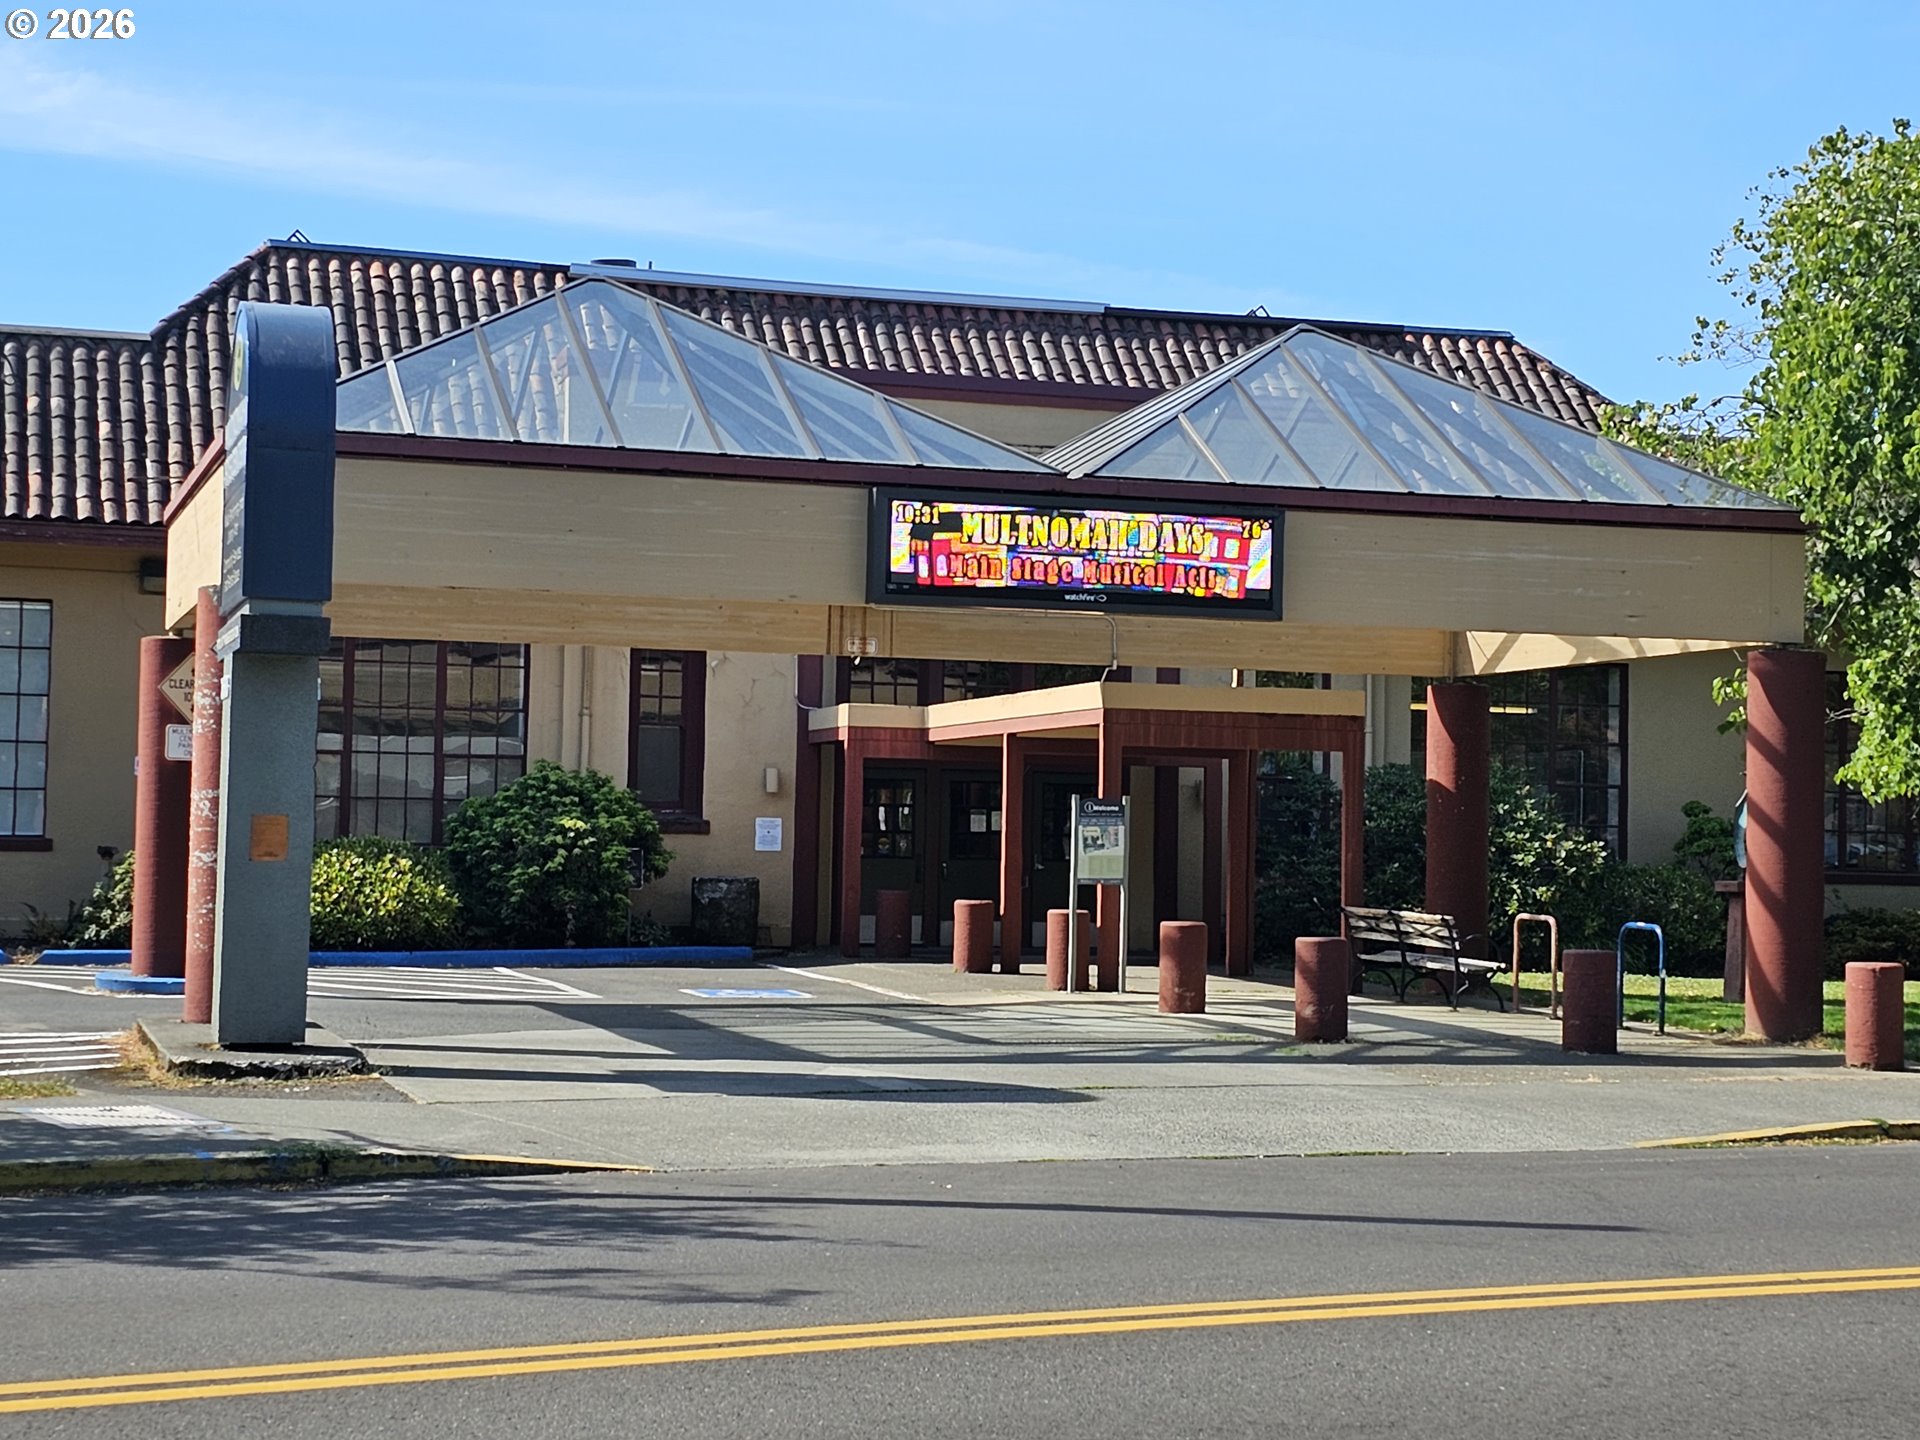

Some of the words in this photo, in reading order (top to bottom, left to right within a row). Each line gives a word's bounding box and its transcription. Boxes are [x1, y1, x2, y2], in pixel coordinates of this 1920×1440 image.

[895, 503, 941, 525] 10:31
[960, 512, 1128, 550] MULTNOMAH
[948, 554, 1003, 580] Main
[1011, 557, 1074, 585] Stage
[1082, 560, 1165, 587] Musical
[1174, 565, 1217, 589] Acts
